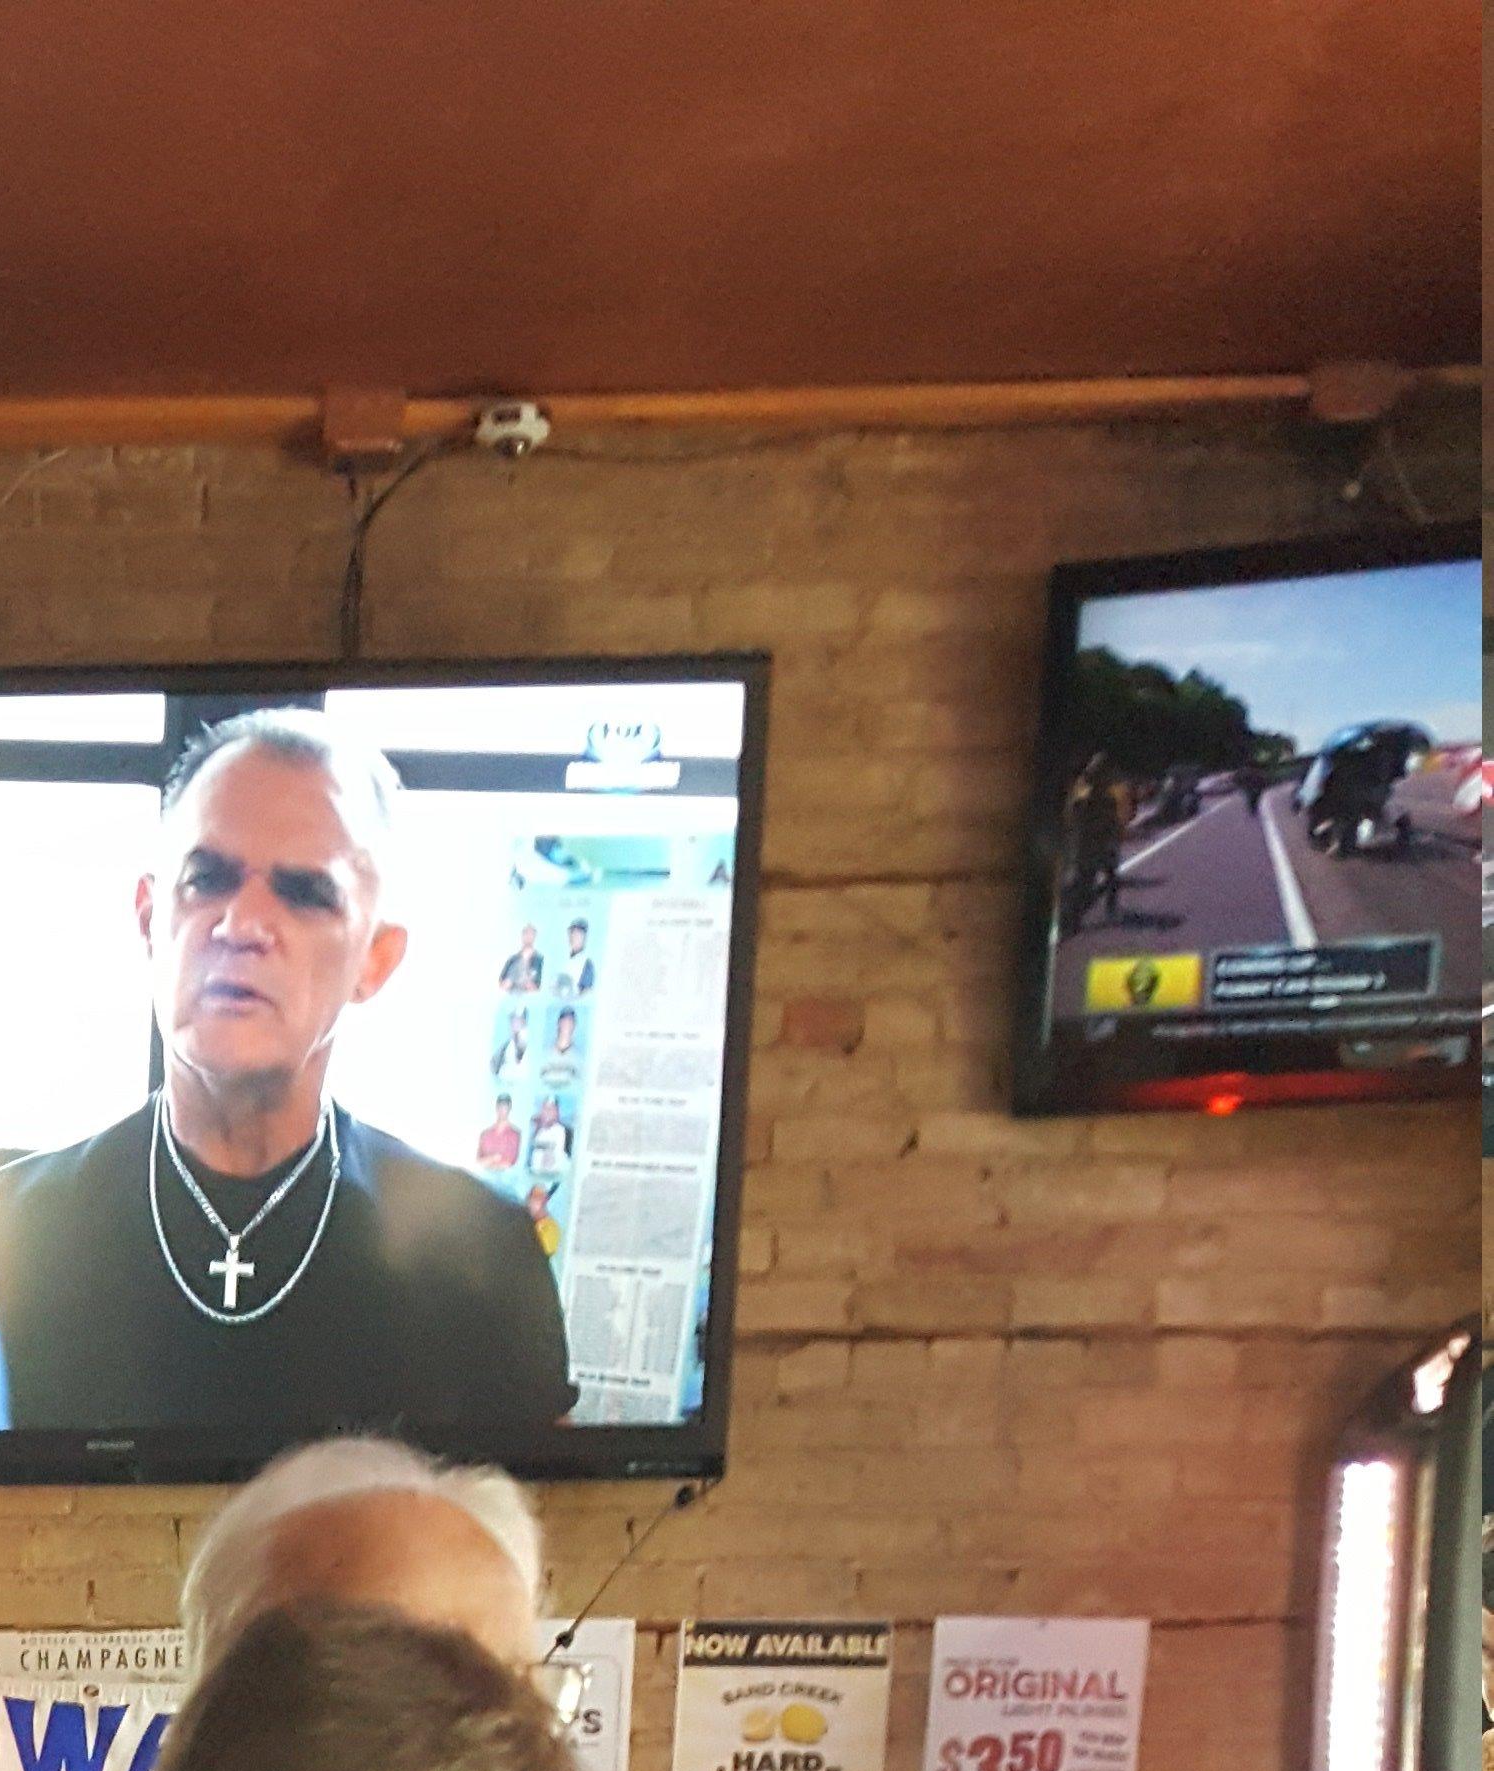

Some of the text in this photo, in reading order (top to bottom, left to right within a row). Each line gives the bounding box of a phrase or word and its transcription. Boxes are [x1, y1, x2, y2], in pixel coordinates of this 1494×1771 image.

[684, 1633, 888, 1658] NOW AVAILABLE
[19, 1646, 186, 1671] CHAMPAGNE
[778, 1682, 844, 1706] CREEK
[944, 1668, 1128, 1701] ORIGINAL
